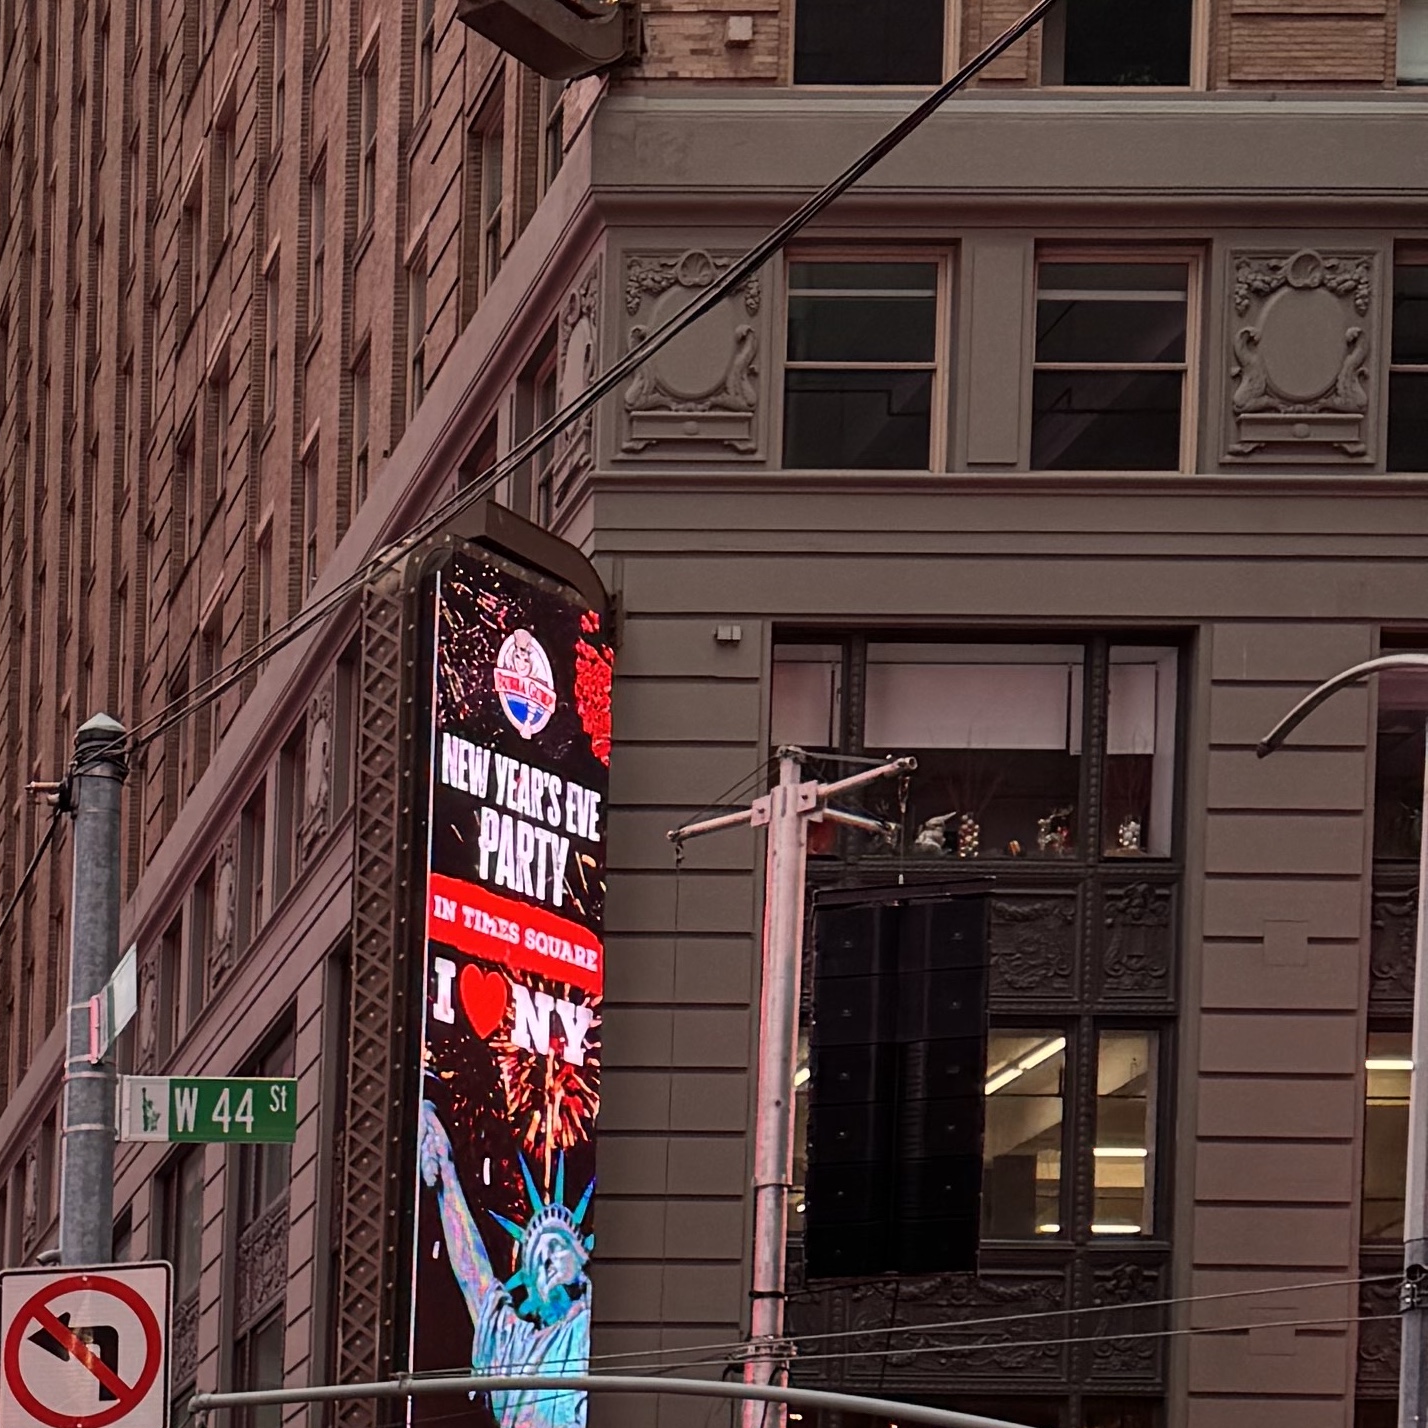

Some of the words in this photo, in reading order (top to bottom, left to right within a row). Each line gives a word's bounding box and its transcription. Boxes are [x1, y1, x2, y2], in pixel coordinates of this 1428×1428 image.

[441, 732, 491, 799] NEW
[494, 752, 562, 828] YEAR'S
[566, 781, 601, 842] EVE
[478, 806, 571, 907] PARTY
[433, 894, 458, 922] IN
[462, 904, 521, 945] TIMES
[524, 928, 599, 972] SQUARE
[433, 956, 457, 1025] I
[510, 982, 594, 1067] NY
[173, 1087, 199, 1133] W
[210, 1086, 255, 1135] 44
[268, 1084, 288, 1114] St
